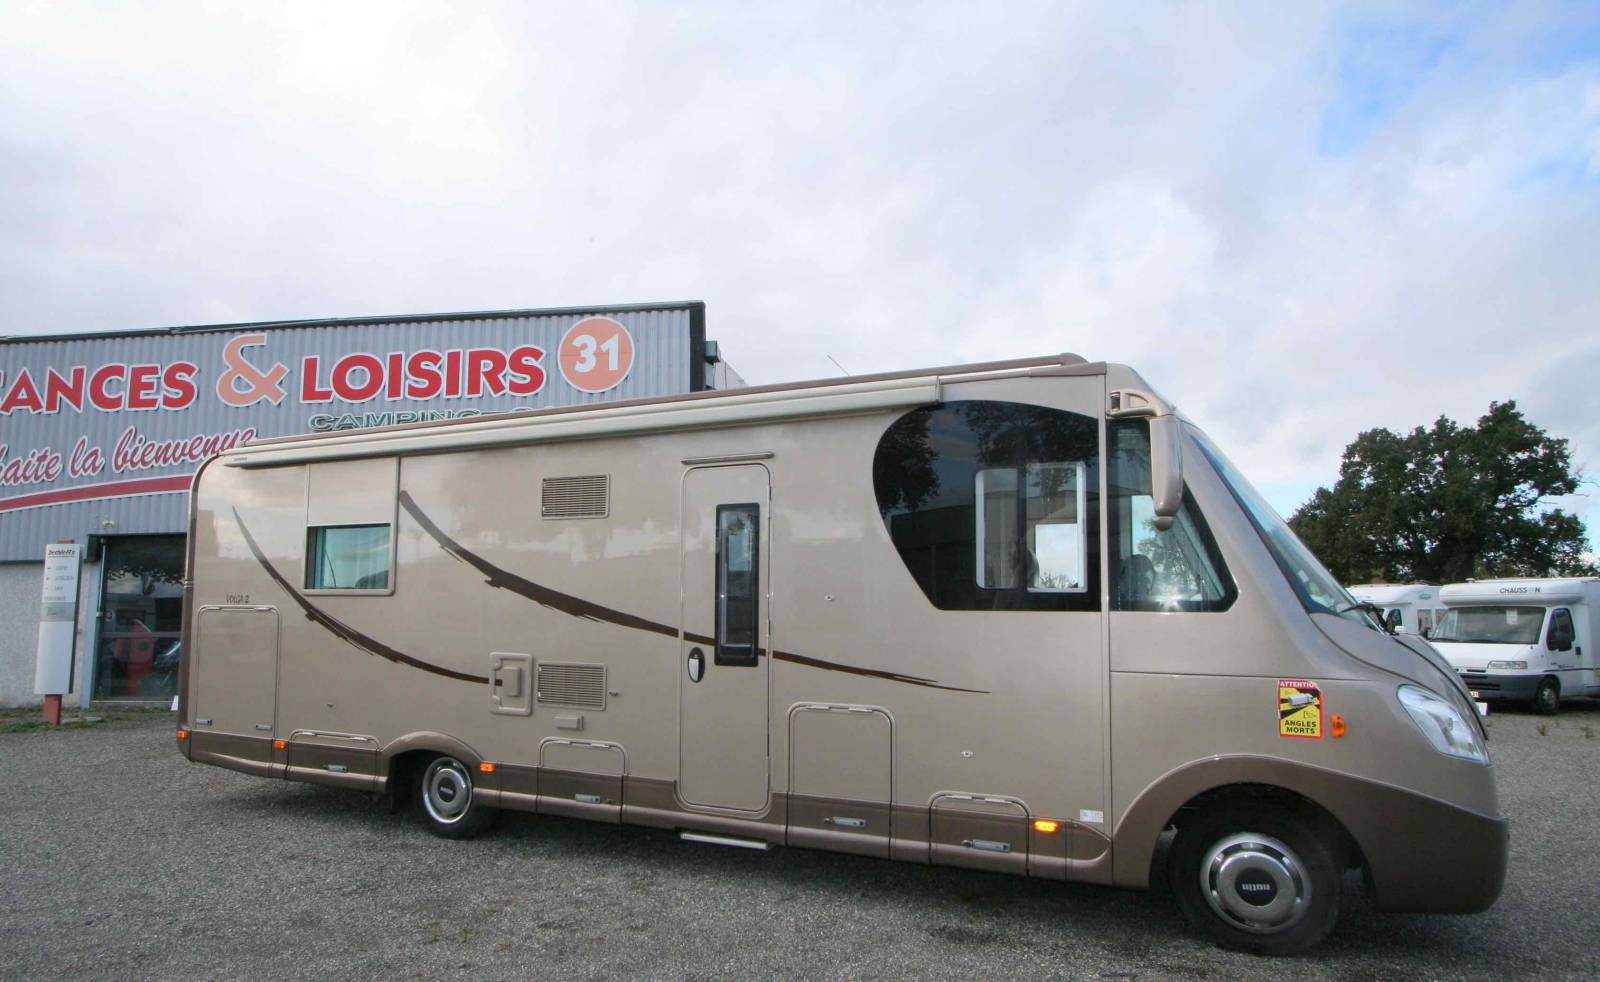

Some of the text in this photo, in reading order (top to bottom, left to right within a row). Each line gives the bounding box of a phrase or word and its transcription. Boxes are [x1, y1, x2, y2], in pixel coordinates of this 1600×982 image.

[0, 333, 620, 415] ANCES & LOISIRS 31
[69, 435, 104, 478] la
[1280, 680, 1318, 688] ATTENTIO
[1284, 720, 1317, 728] ANGLES
[1286, 727, 1315, 735] MORTS
